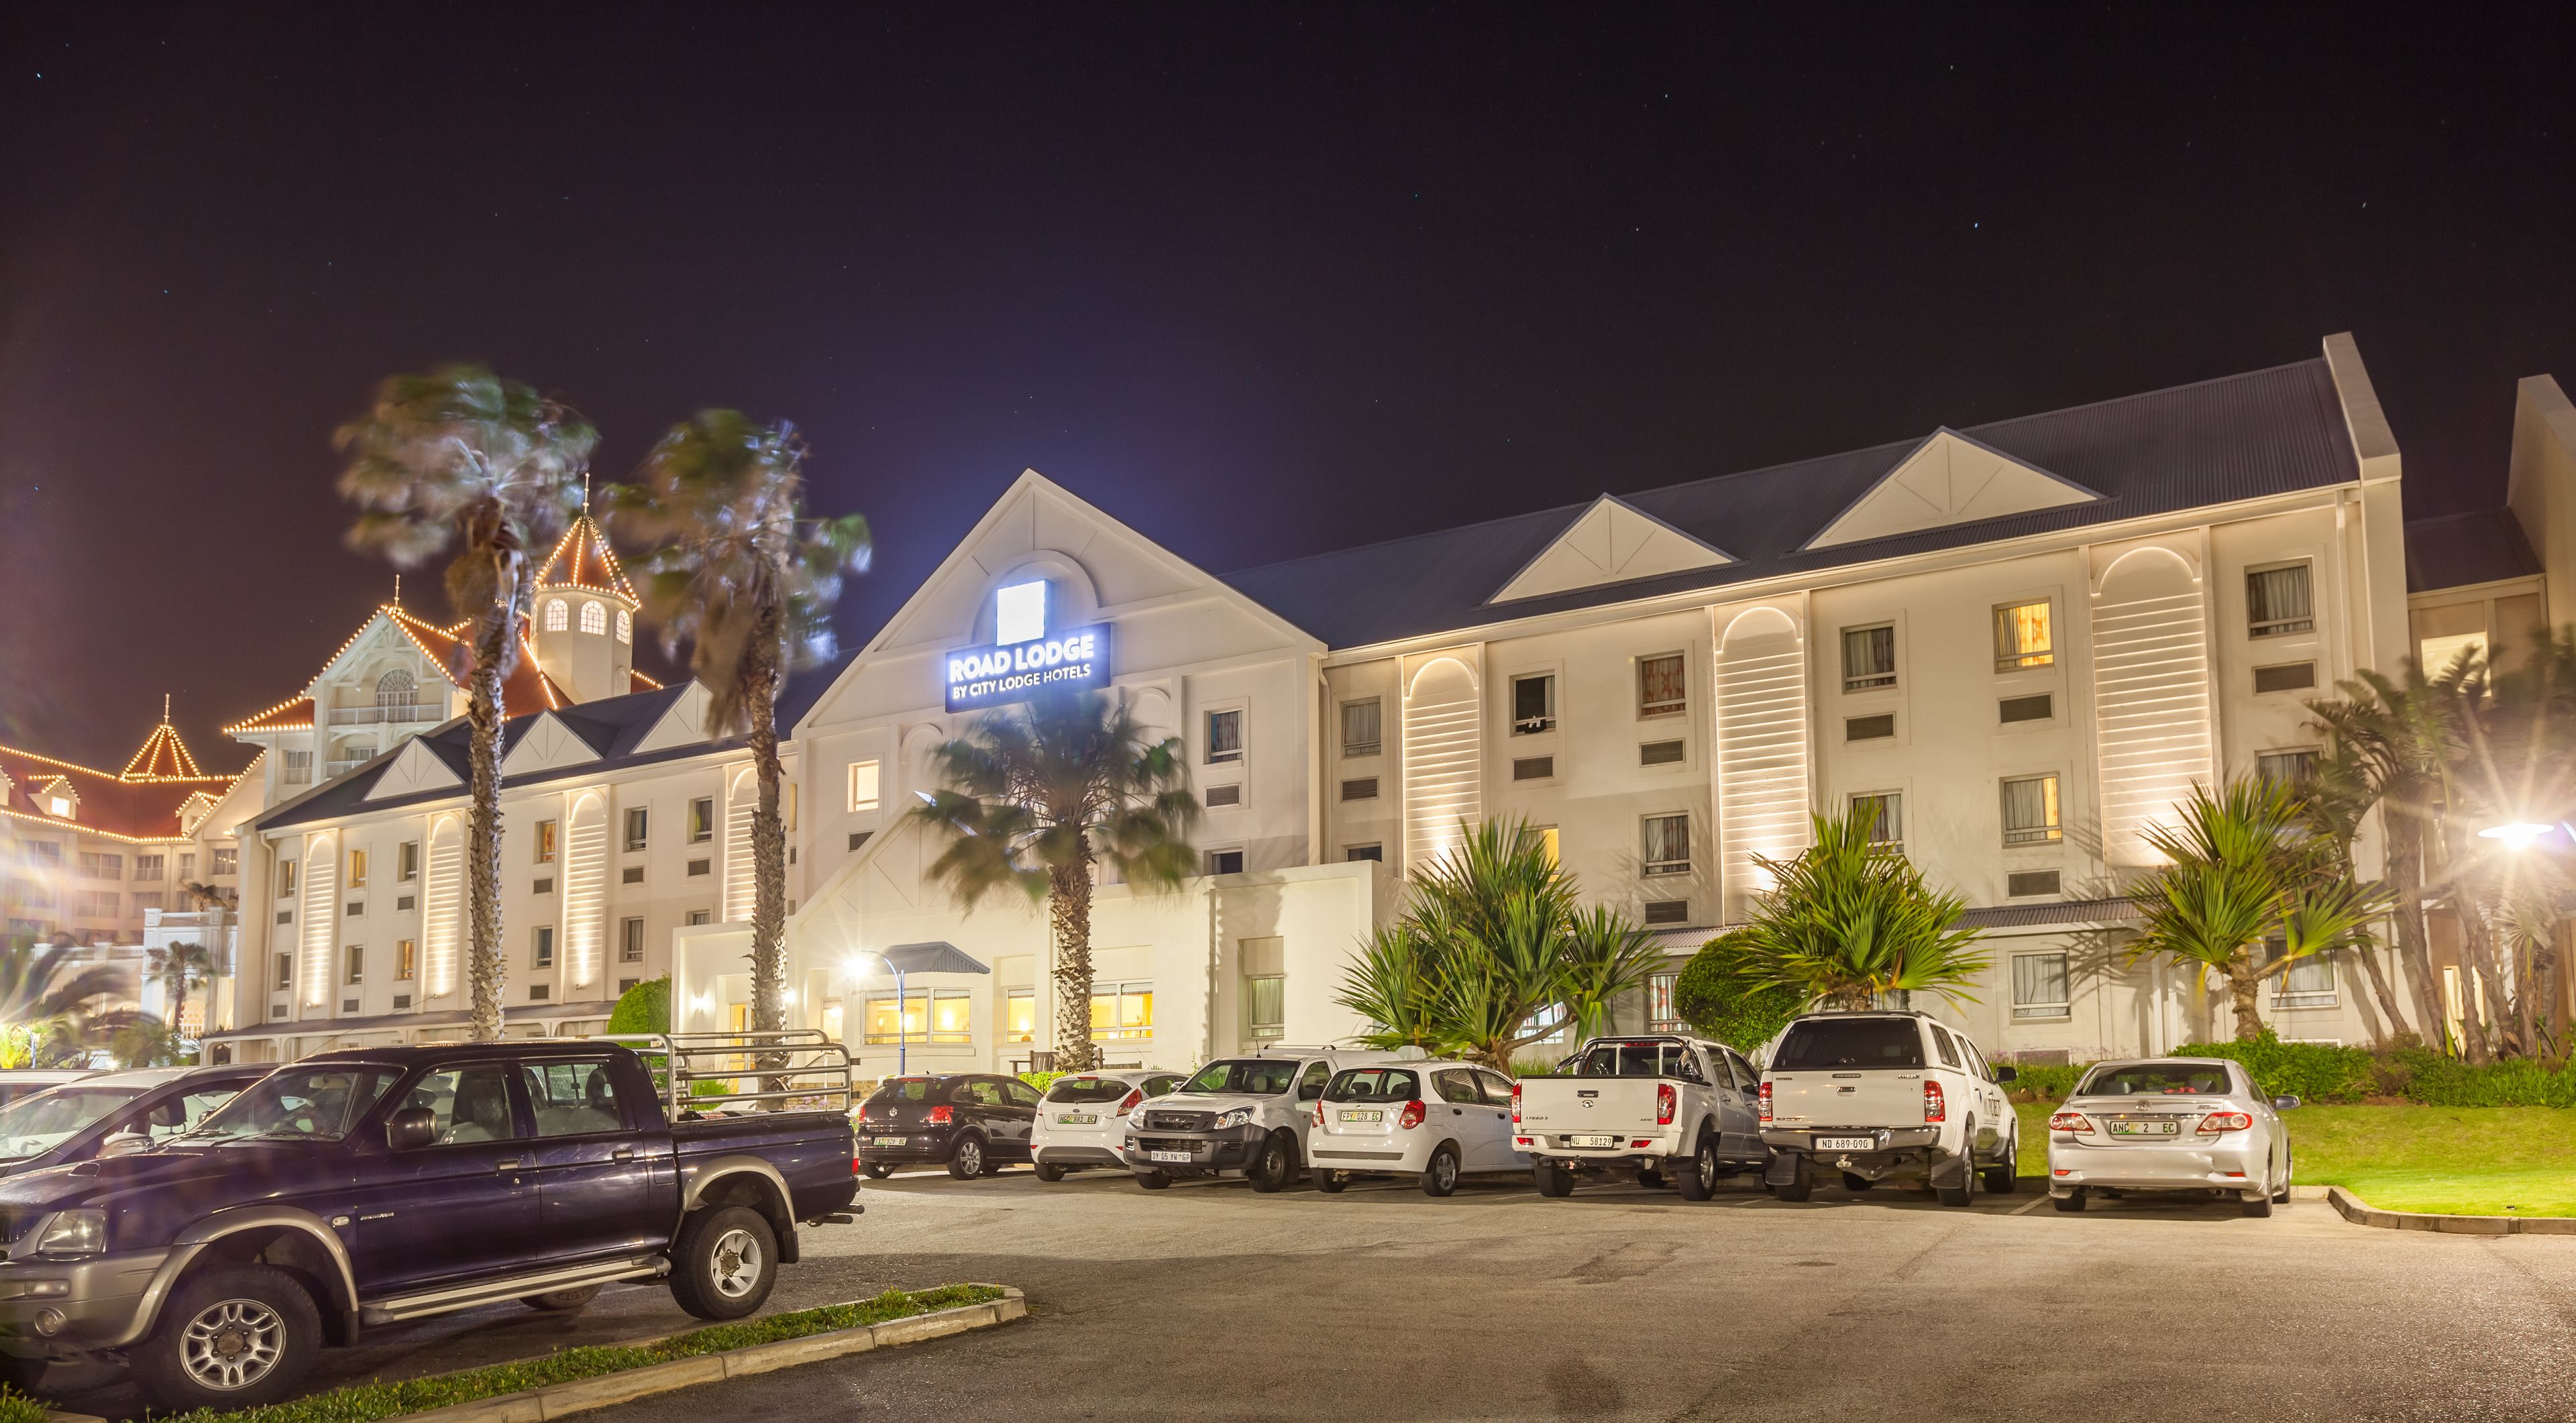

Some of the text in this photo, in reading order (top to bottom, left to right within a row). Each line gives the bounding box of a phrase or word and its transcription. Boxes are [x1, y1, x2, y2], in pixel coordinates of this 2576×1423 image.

[949, 635, 1095, 682] ROAD LODGE
[953, 664, 1091, 699] BY CITY LODGE HOTELS
[1342, 1112, 1379, 1120] FPY 028 EC
[2112, 1123, 2174, 1132] ANC 2 EC
[1571, 1137, 1612, 1146] NU 58129
[1822, 1139, 1832, 1149] ND
